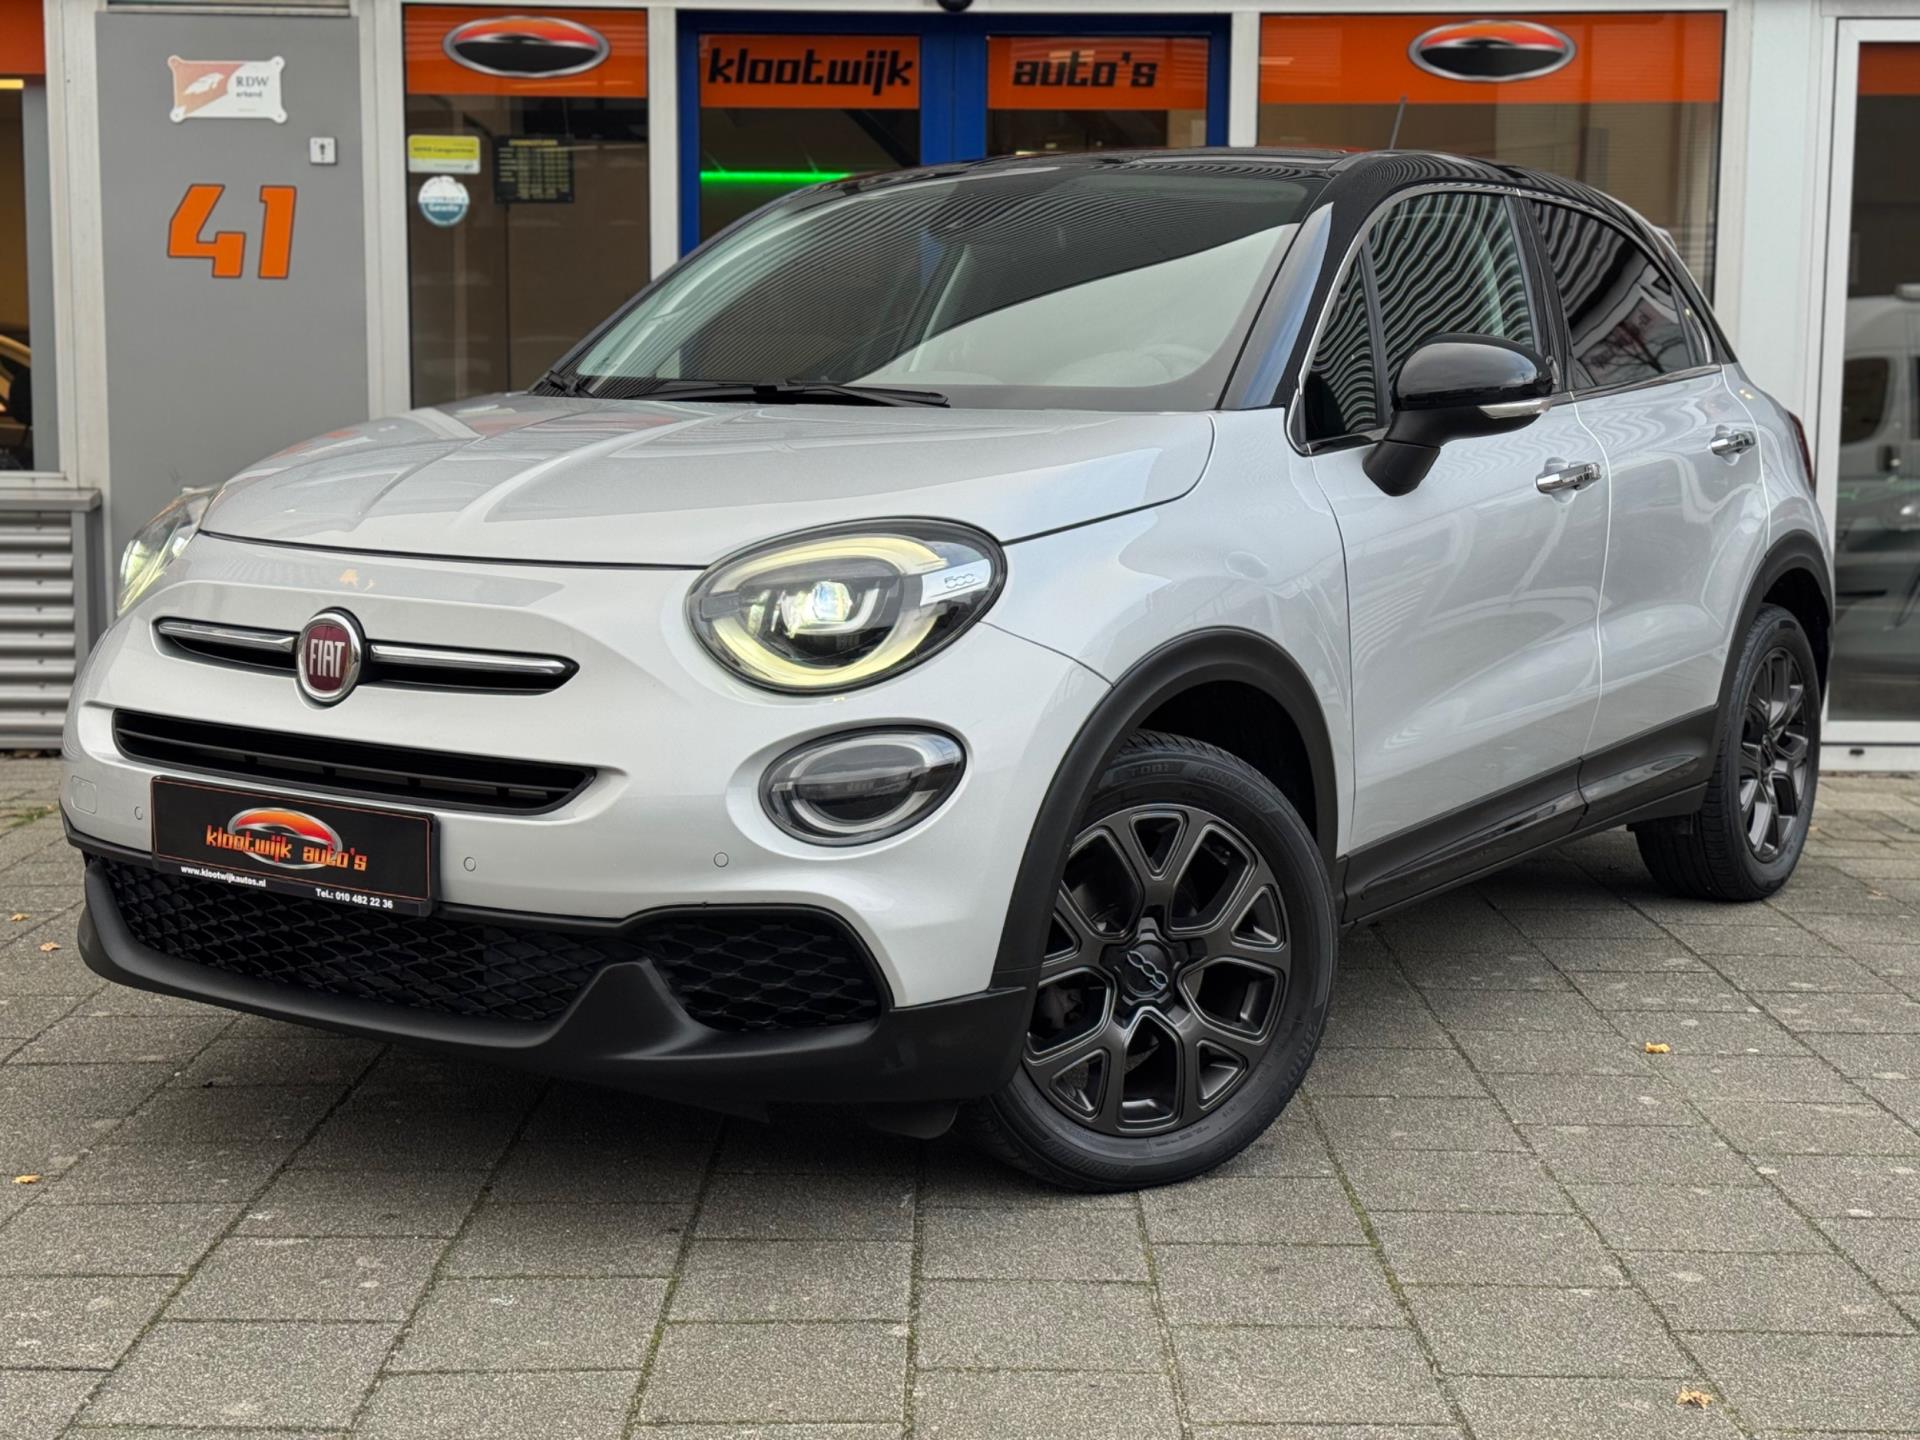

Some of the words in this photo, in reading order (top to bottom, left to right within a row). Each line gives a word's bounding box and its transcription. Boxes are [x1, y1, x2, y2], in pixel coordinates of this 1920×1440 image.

[236, 76, 270, 87] RDW
[708, 48, 913, 96] klootwijk
[1012, 50, 1158, 88] auto's
[167, 183, 297, 280] 41
[944, 573, 975, 589] 500
[309, 638, 345, 678] FIAT
[206, 825, 293, 864] klootwijk
[303, 843, 368, 871] auto's
[181, 866, 266, 888] www.klootwijkautos.nl
[335, 891, 351, 902] 010
[352, 894, 368, 905] 482
[369, 897, 380, 907] 22
[382, 899, 393, 909] 36
